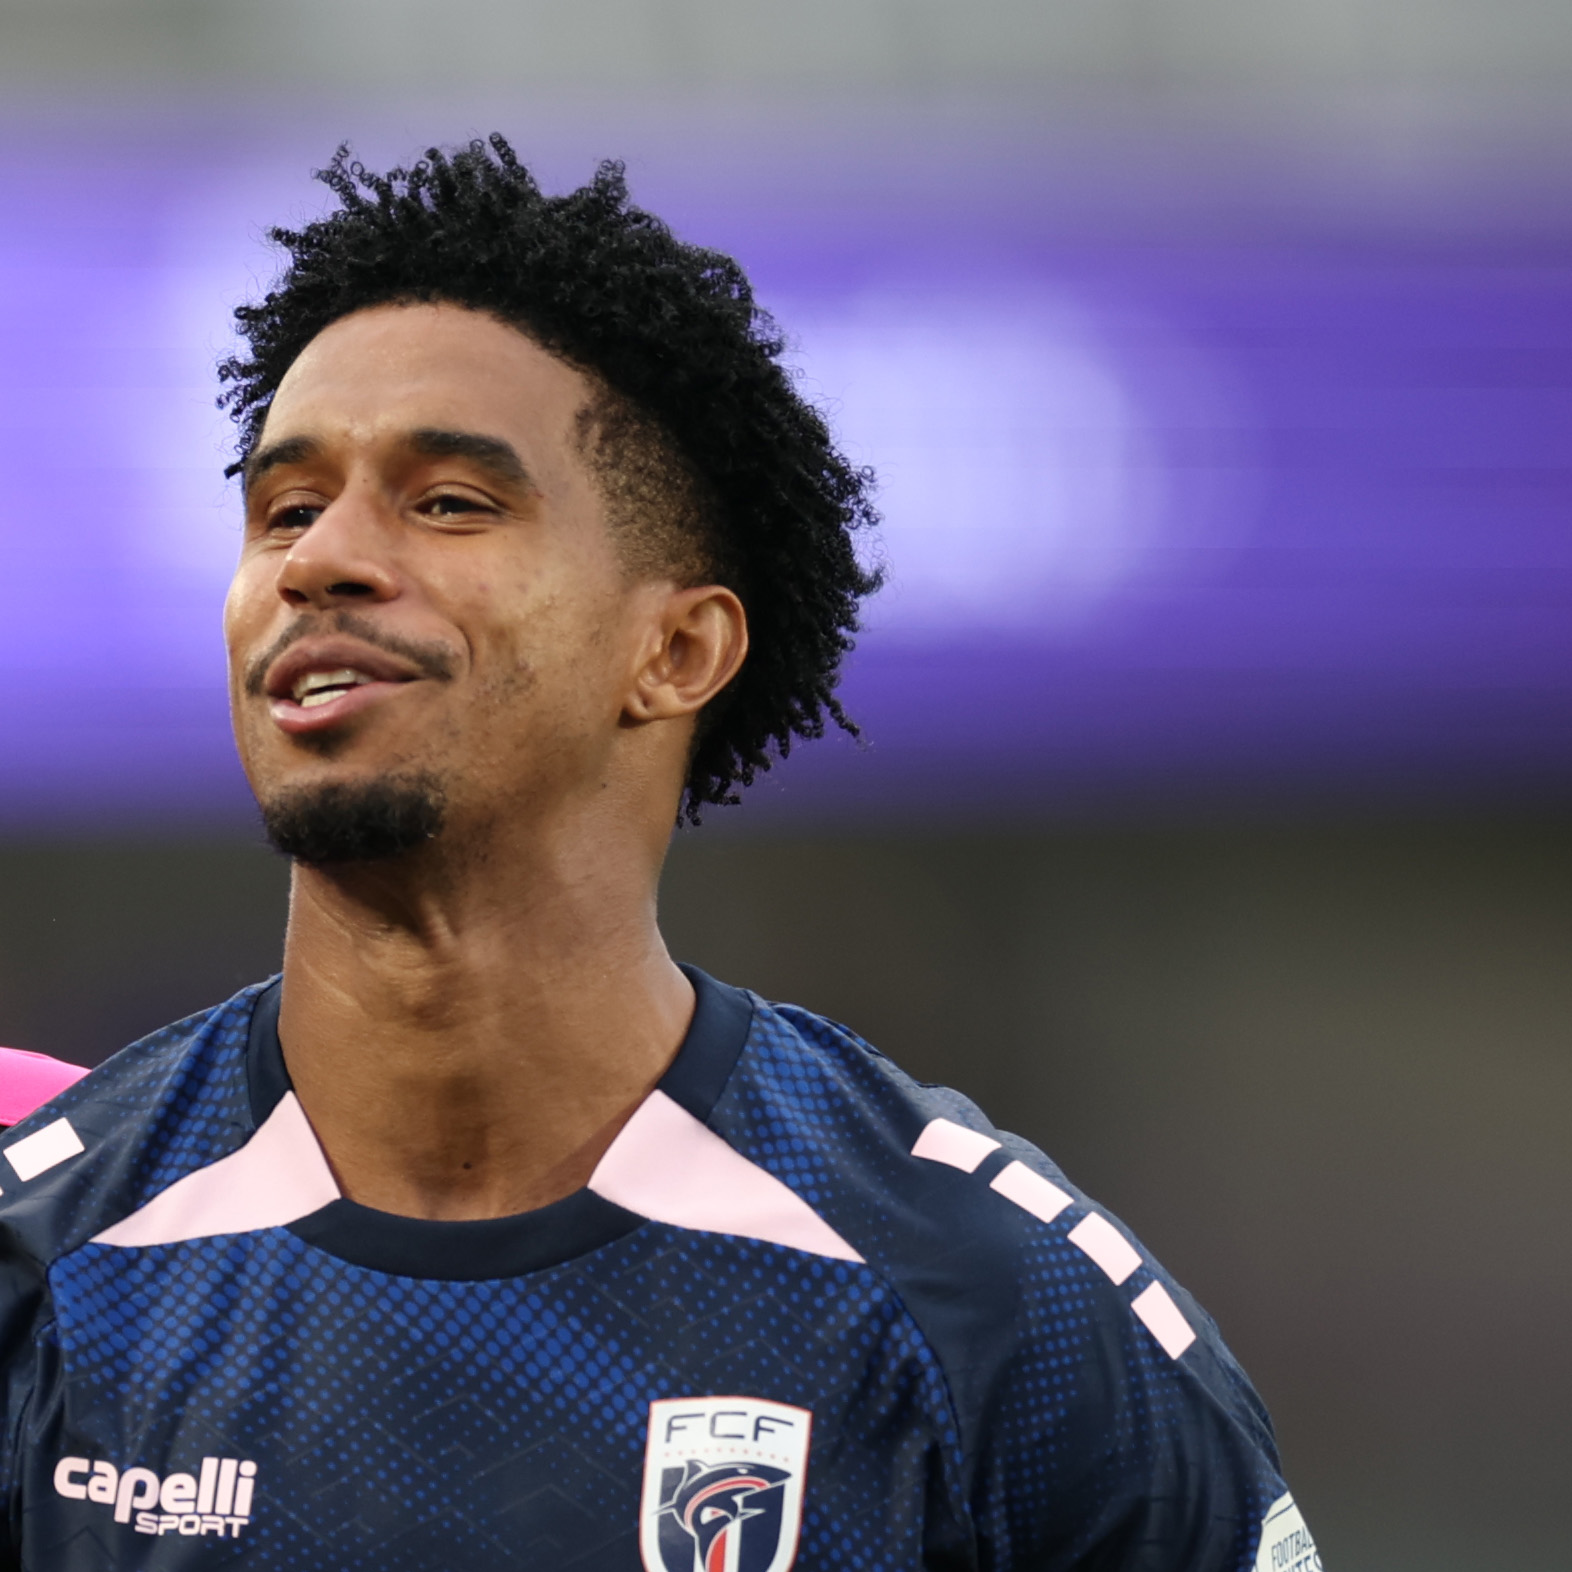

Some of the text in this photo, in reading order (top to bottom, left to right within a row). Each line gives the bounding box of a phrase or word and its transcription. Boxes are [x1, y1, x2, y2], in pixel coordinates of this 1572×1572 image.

[664, 1411, 794, 1443] FCF
[53, 1455, 258, 1524] capelli
[134, 1511, 250, 1539] SPORT
